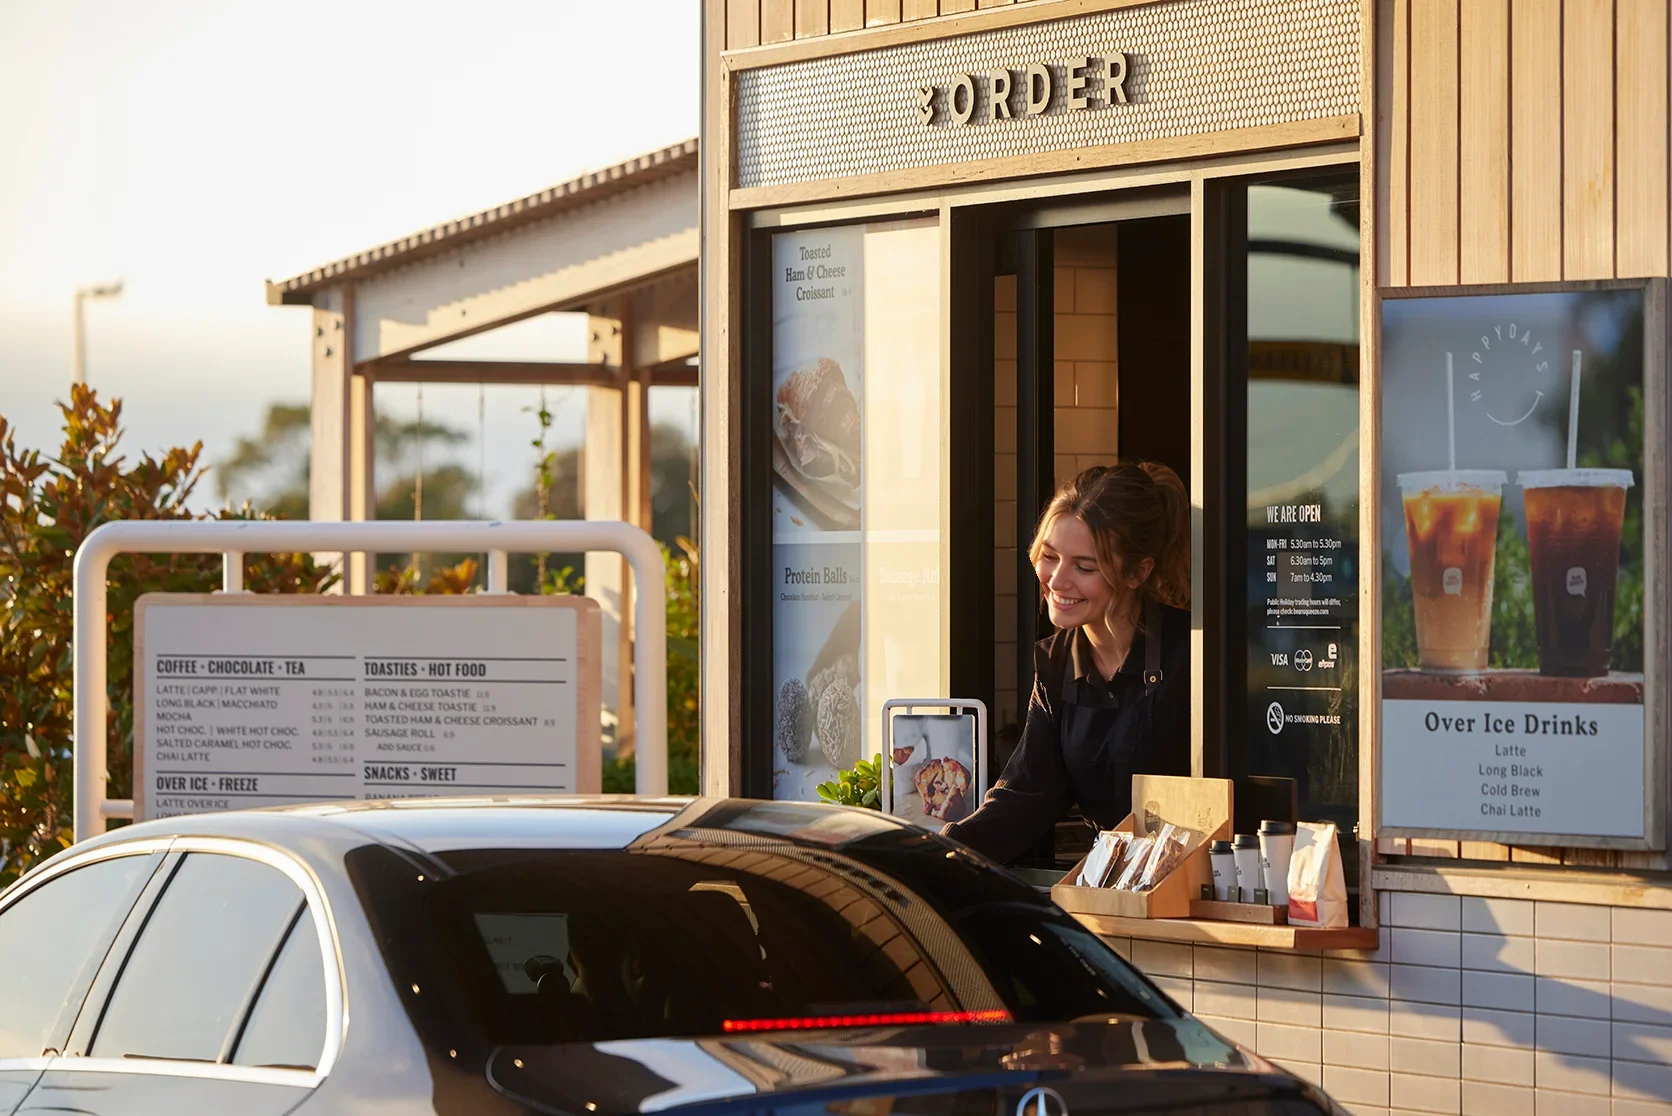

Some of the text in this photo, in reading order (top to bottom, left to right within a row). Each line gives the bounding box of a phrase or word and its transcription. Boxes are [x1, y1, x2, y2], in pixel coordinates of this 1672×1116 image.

[950, 52, 1127, 125] ORDER
[800, 244, 831, 260] Toasted
[786, 264, 846, 282] Ham & Cheese
[796, 286, 835, 301] Croissant
[1266, 504, 1320, 522] WE ARE OPEN
[1290, 539, 1312, 549] 5.30am
[1312, 540, 1318, 549] to
[1320, 538, 1342, 550] 5.30pm
[1266, 555, 1332, 566] SAT 6.30am to 5pm
[784, 567, 820, 584] Protein
[824, 566, 848, 584] Balls
[1266, 572, 1332, 583] SUN 7am to 4.30pm
[1266, 598, 1280, 606] Public
[1280, 598, 1294, 607] Holiday
[1294, 598, 1309, 607] trading
[1270, 654, 1288, 666] VISA
[156, 660, 305, 676] COFFEE CHOCOLATE TEA
[364, 662, 486, 677] TOASTIES HOT FOOD
[156, 684, 186, 695] LATTE
[224, 685, 247, 696] FLAT
[248, 686, 280, 696] WHITE
[364, 688, 398, 698] BACON
[400, 688, 408, 698] &
[410, 688, 429, 698] EGG
[430, 688, 471, 699] TOASTIE
[156, 699, 278, 710] LONG BLACK MACCHIATO
[364, 701, 387, 711] HAM
[388, 702, 396, 711] &
[398, 702, 434, 712] CHEESE
[438, 702, 477, 712] TOASTIE
[156, 712, 192, 722] MOCHA
[365, 714, 408, 724] TOASTED
[410, 716, 432, 725] HAM
[434, 716, 442, 725] &
[443, 716, 481, 726] CHEESE
[482, 716, 538, 726] CROISSANT
[1285, 714, 1341, 724] NO SMOKING PLEASE
[1424, 711, 1598, 736] Over Ice Drinks
[156, 726, 174, 735] HOT
[216, 726, 248, 736] WHITE
[249, 727, 268, 736] HOT
[364, 728, 408, 738] SAUSAGE
[410, 728, 436, 739] ROLL
[156, 739, 192, 749] SALTED
[194, 740, 240, 750] CARAMEL
[242, 740, 261, 750] HOT
[377, 743, 394, 752] ADD
[396, 743, 422, 752] SAUCE
[1495, 744, 1526, 757] Latte
[156, 752, 180, 761] CHAI
[180, 752, 210, 762] LATTE
[364, 766, 456, 782] SNACKS SWEET
[1478, 763, 1544, 778] Long Black
[156, 776, 258, 792] OVER ICE FREEZE
[1481, 783, 1541, 798] Cold Brew
[156, 798, 230, 810] LATTE OVER ICE
[1480, 803, 1542, 818] Chai Latte
